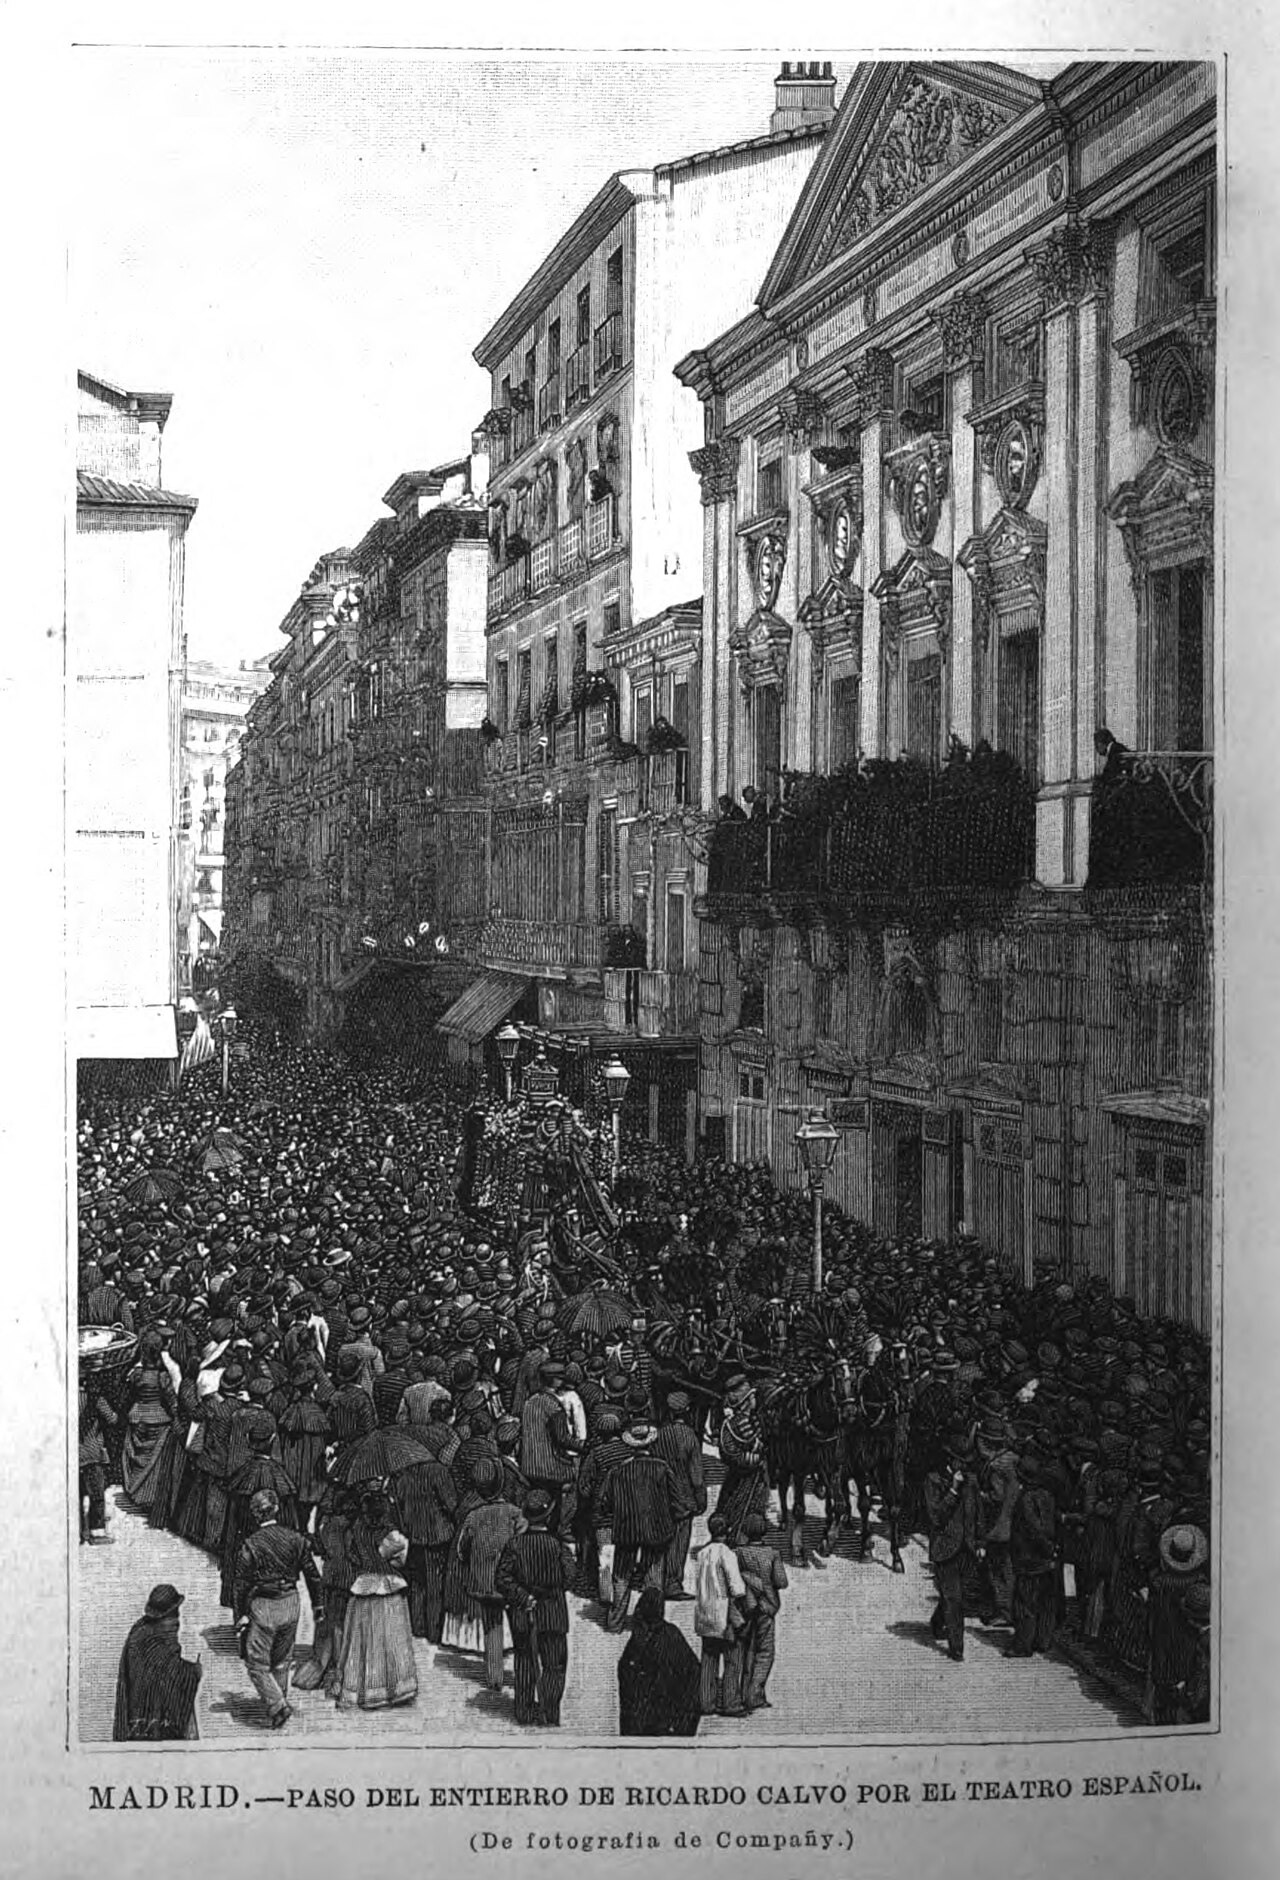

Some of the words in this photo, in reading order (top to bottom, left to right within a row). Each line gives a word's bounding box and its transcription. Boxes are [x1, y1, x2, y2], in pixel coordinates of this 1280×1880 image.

[365, 1787, 420, 1808] DEL
[428, 1786, 569, 1807] ENTIERRO
[578, 1786, 615, 1806] DE
[624, 1786, 747, 1806] RICARDO
[756, 1785, 847, 1806] CALVO
[856, 1784, 911, 1805] POR
[921, 1782, 957, 1803] EL
[965, 1779, 1073, 1801] TEATRO
[1081, 1770, 1202, 1797] ESPAÑOL.
[469, 1831, 513, 1854] (De
[673, 1831, 702, 1849] de
[716, 1828, 854, 1852] Compañy.)
